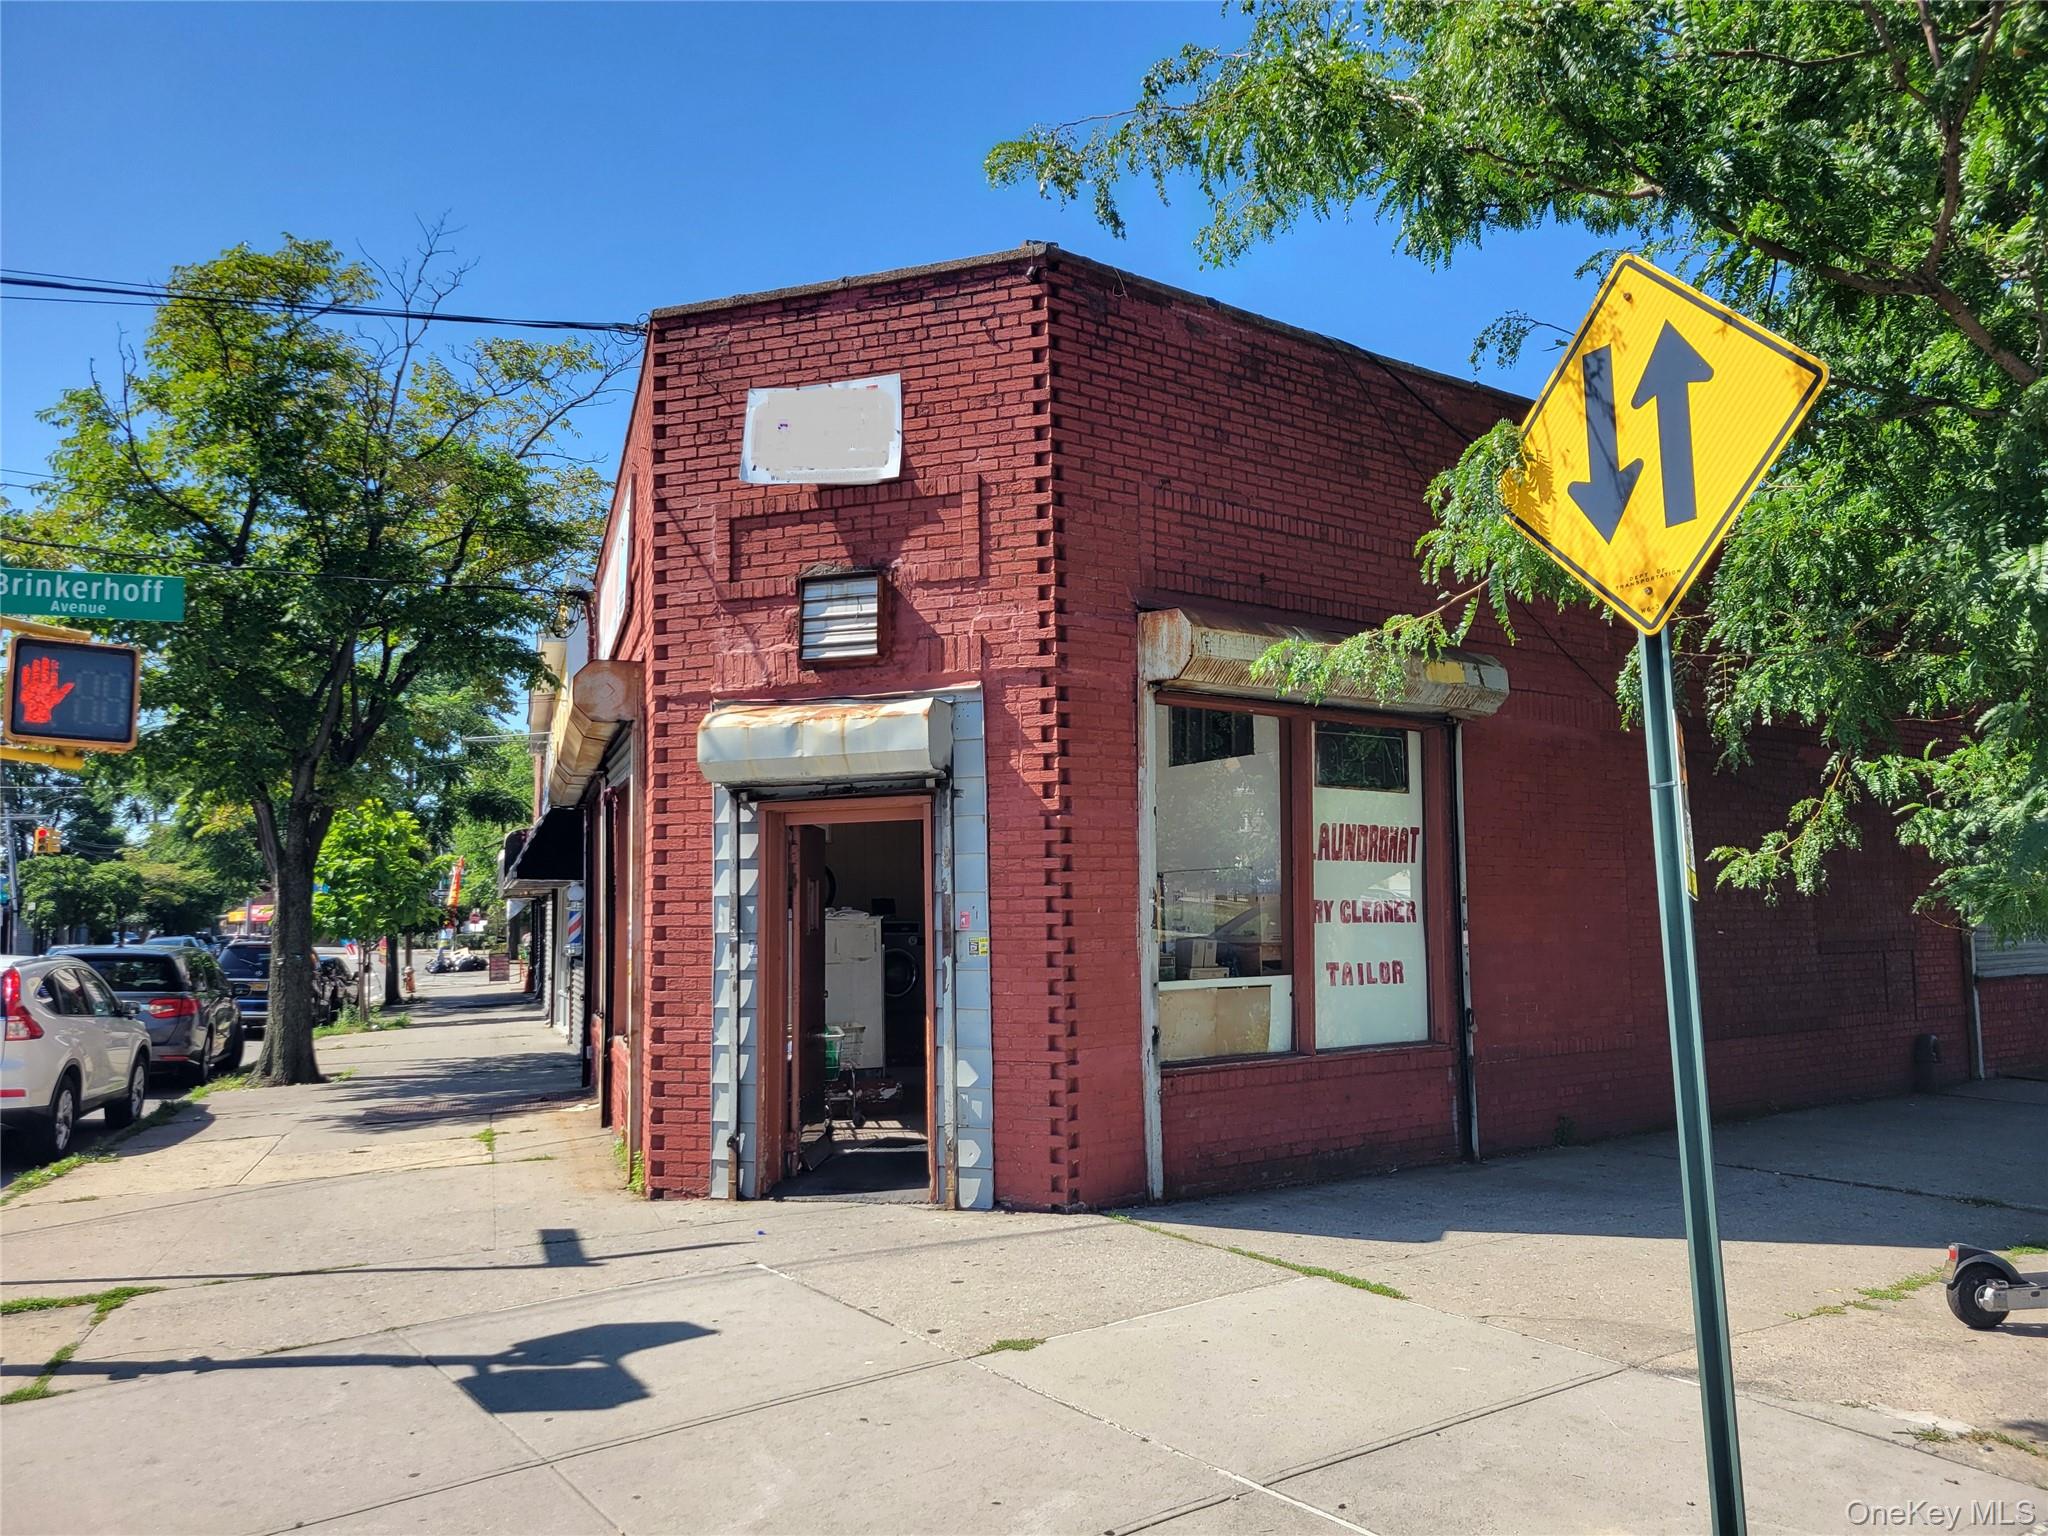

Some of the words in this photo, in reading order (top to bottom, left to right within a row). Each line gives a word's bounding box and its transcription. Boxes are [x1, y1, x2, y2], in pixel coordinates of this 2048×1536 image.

[1615, 568, 1682, 591] TRANSPORTATION
[1656, 567, 1665, 575] OF
[0, 572, 164, 603] Brinkerhoff
[51, 600, 107, 615] Avenue
[1312, 822, 1420, 864] AUNDROMAT
[1340, 899, 1417, 924] CLEANER
[1326, 960, 1404, 987] TAILOR
